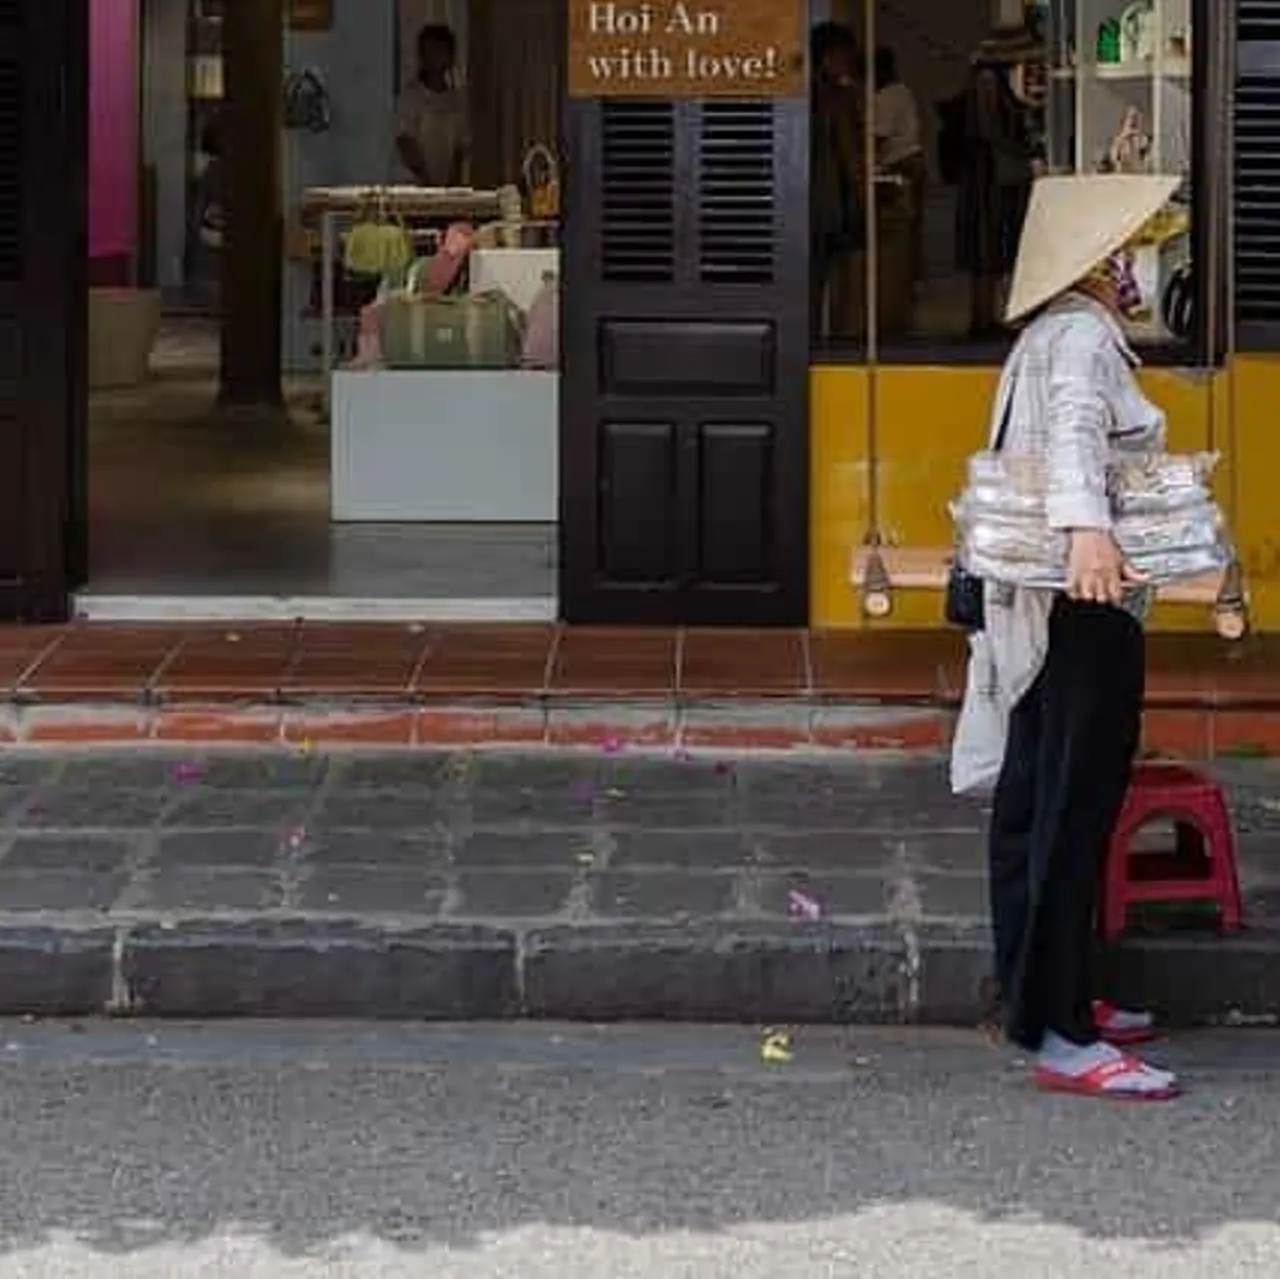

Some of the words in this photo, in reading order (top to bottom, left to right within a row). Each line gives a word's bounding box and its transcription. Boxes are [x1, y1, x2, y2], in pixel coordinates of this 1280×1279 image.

[589, 2, 651, 33] Hoi
[665, 1, 718, 34] An
[589, 48, 671, 78] with
[687, 47, 776, 78] love!
